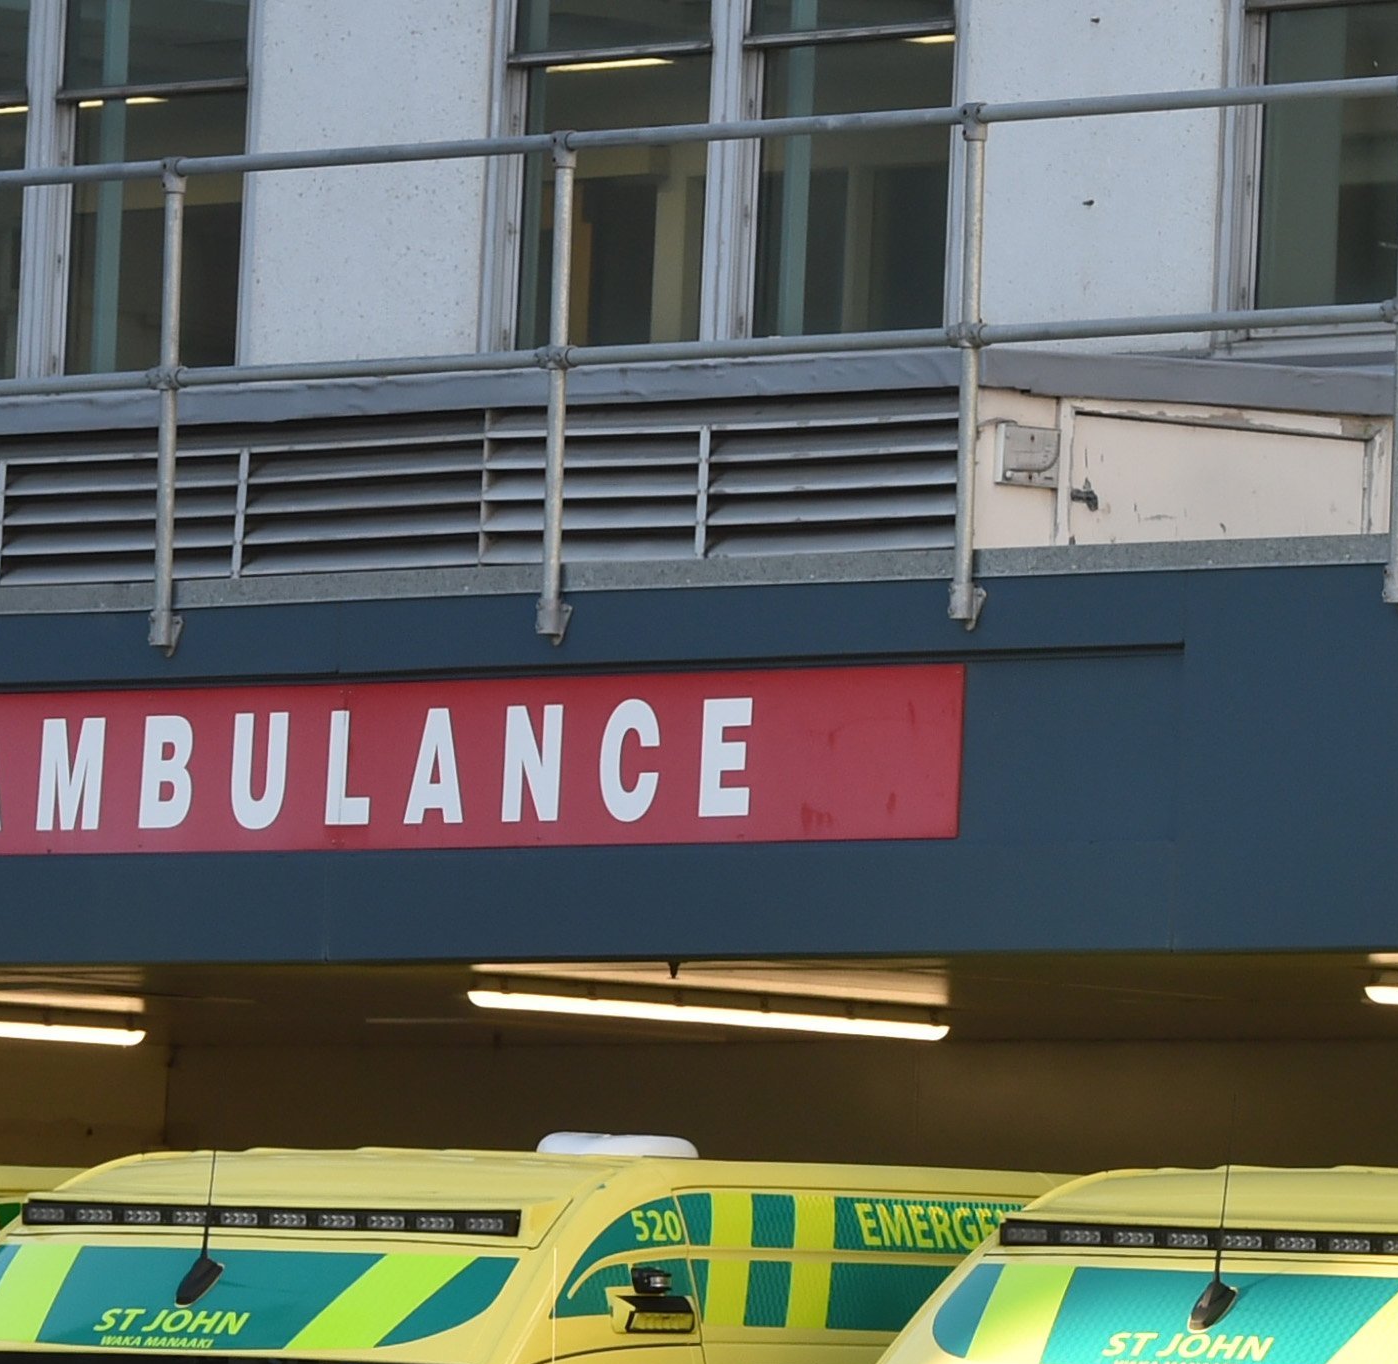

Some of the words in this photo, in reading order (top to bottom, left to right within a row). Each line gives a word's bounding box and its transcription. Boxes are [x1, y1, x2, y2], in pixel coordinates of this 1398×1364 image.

[630, 1210, 683, 1242] 520
[854, 1202, 1004, 1250] EMERGE
[93, 1308, 146, 1332] ST
[141, 1309, 250, 1336] JOHN
[100, 1335, 142, 1347] WAKA
[144, 1336, 214, 1349] MANAAKI
[1102, 1332, 1158, 1357] ST
[1155, 1333, 1274, 1362] JOHN
